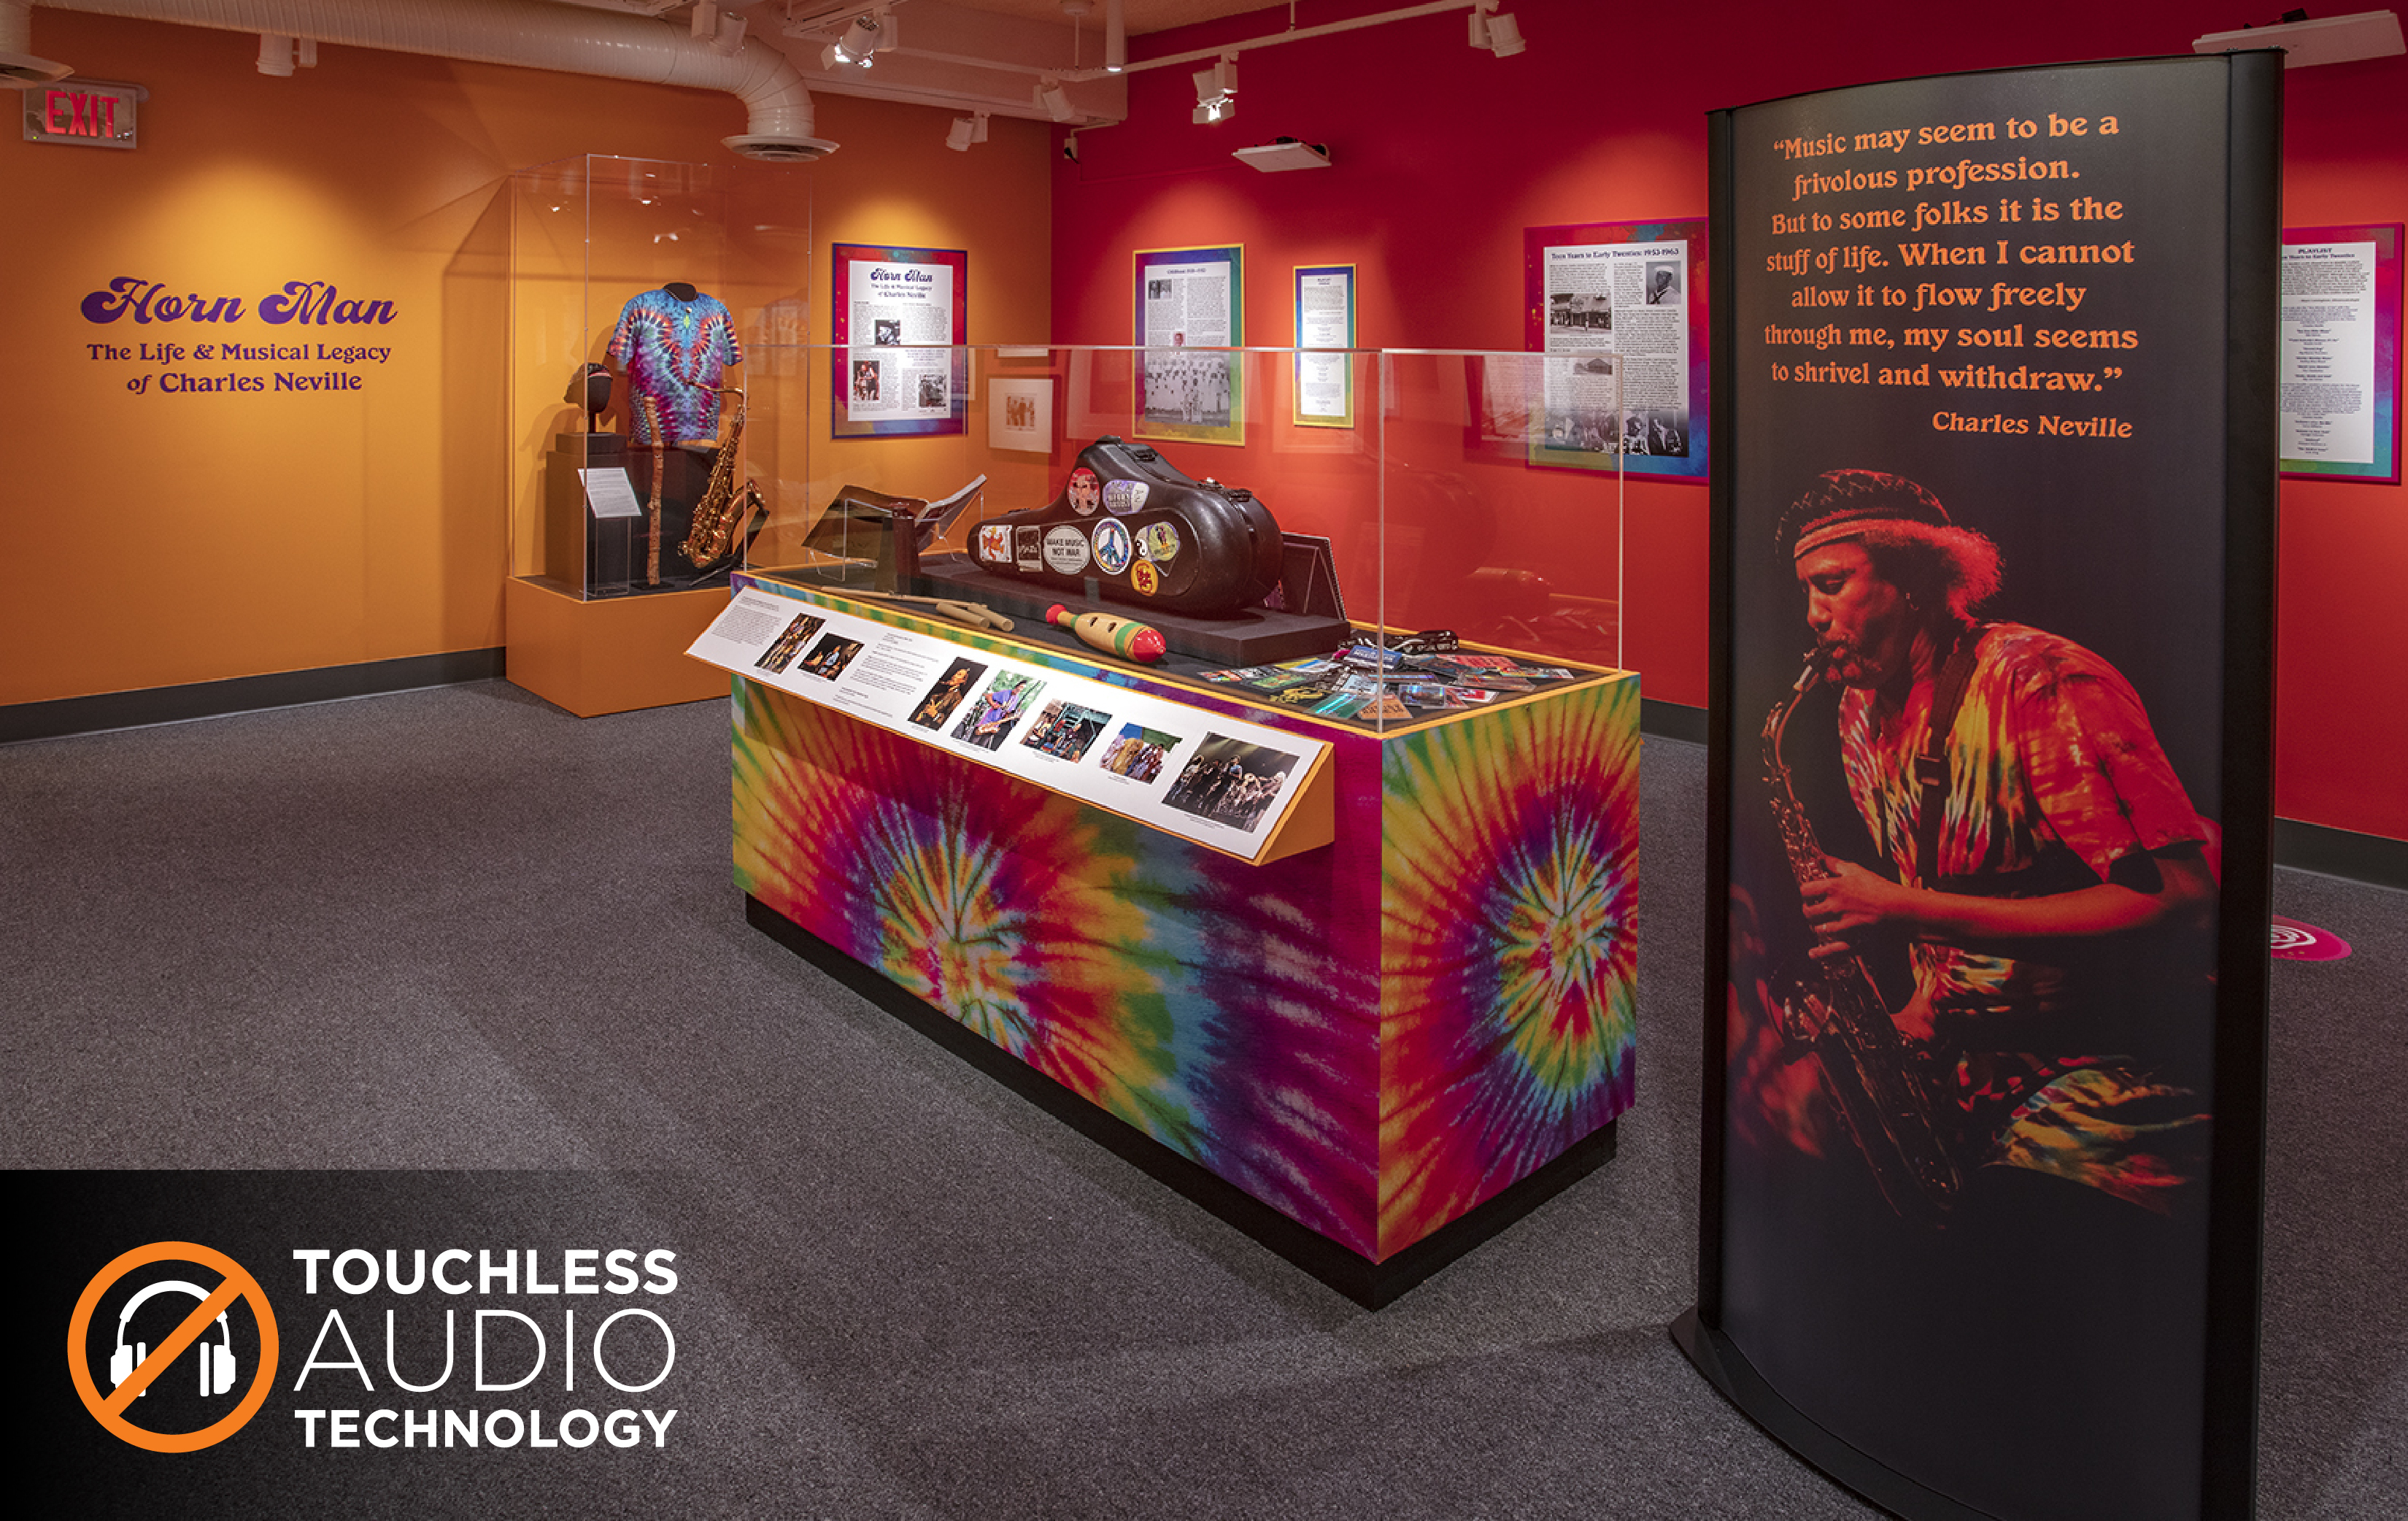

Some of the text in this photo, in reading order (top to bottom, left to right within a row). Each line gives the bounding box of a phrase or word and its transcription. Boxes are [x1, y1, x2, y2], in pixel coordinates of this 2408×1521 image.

[45, 91, 117, 137] EXIT
[1774, 112, 2119, 160] “Music may seem to be a
[1792, 157, 2080, 201] frivolous profession.
[1772, 196, 2123, 234] But to some folks it is the
[1767, 240, 2134, 275] stuff of life. When I cannot
[871, 267, 933, 282] Horn Man
[80, 277, 397, 324] Horn Man
[1792, 282, 2087, 312] allow it to flow freely
[1765, 324, 2139, 352] through me, my soul seems
[87, 344, 390, 365] The Life & Musical Legacy
[128, 373, 360, 394] of Charles Neville
[1772, 362, 2122, 391] to shrivel and withdraw.”
[1932, 412, 2133, 438] Charles Neville
[1052, 547, 1064, 555] NOT
[1067, 549, 1081, 557] WAR
